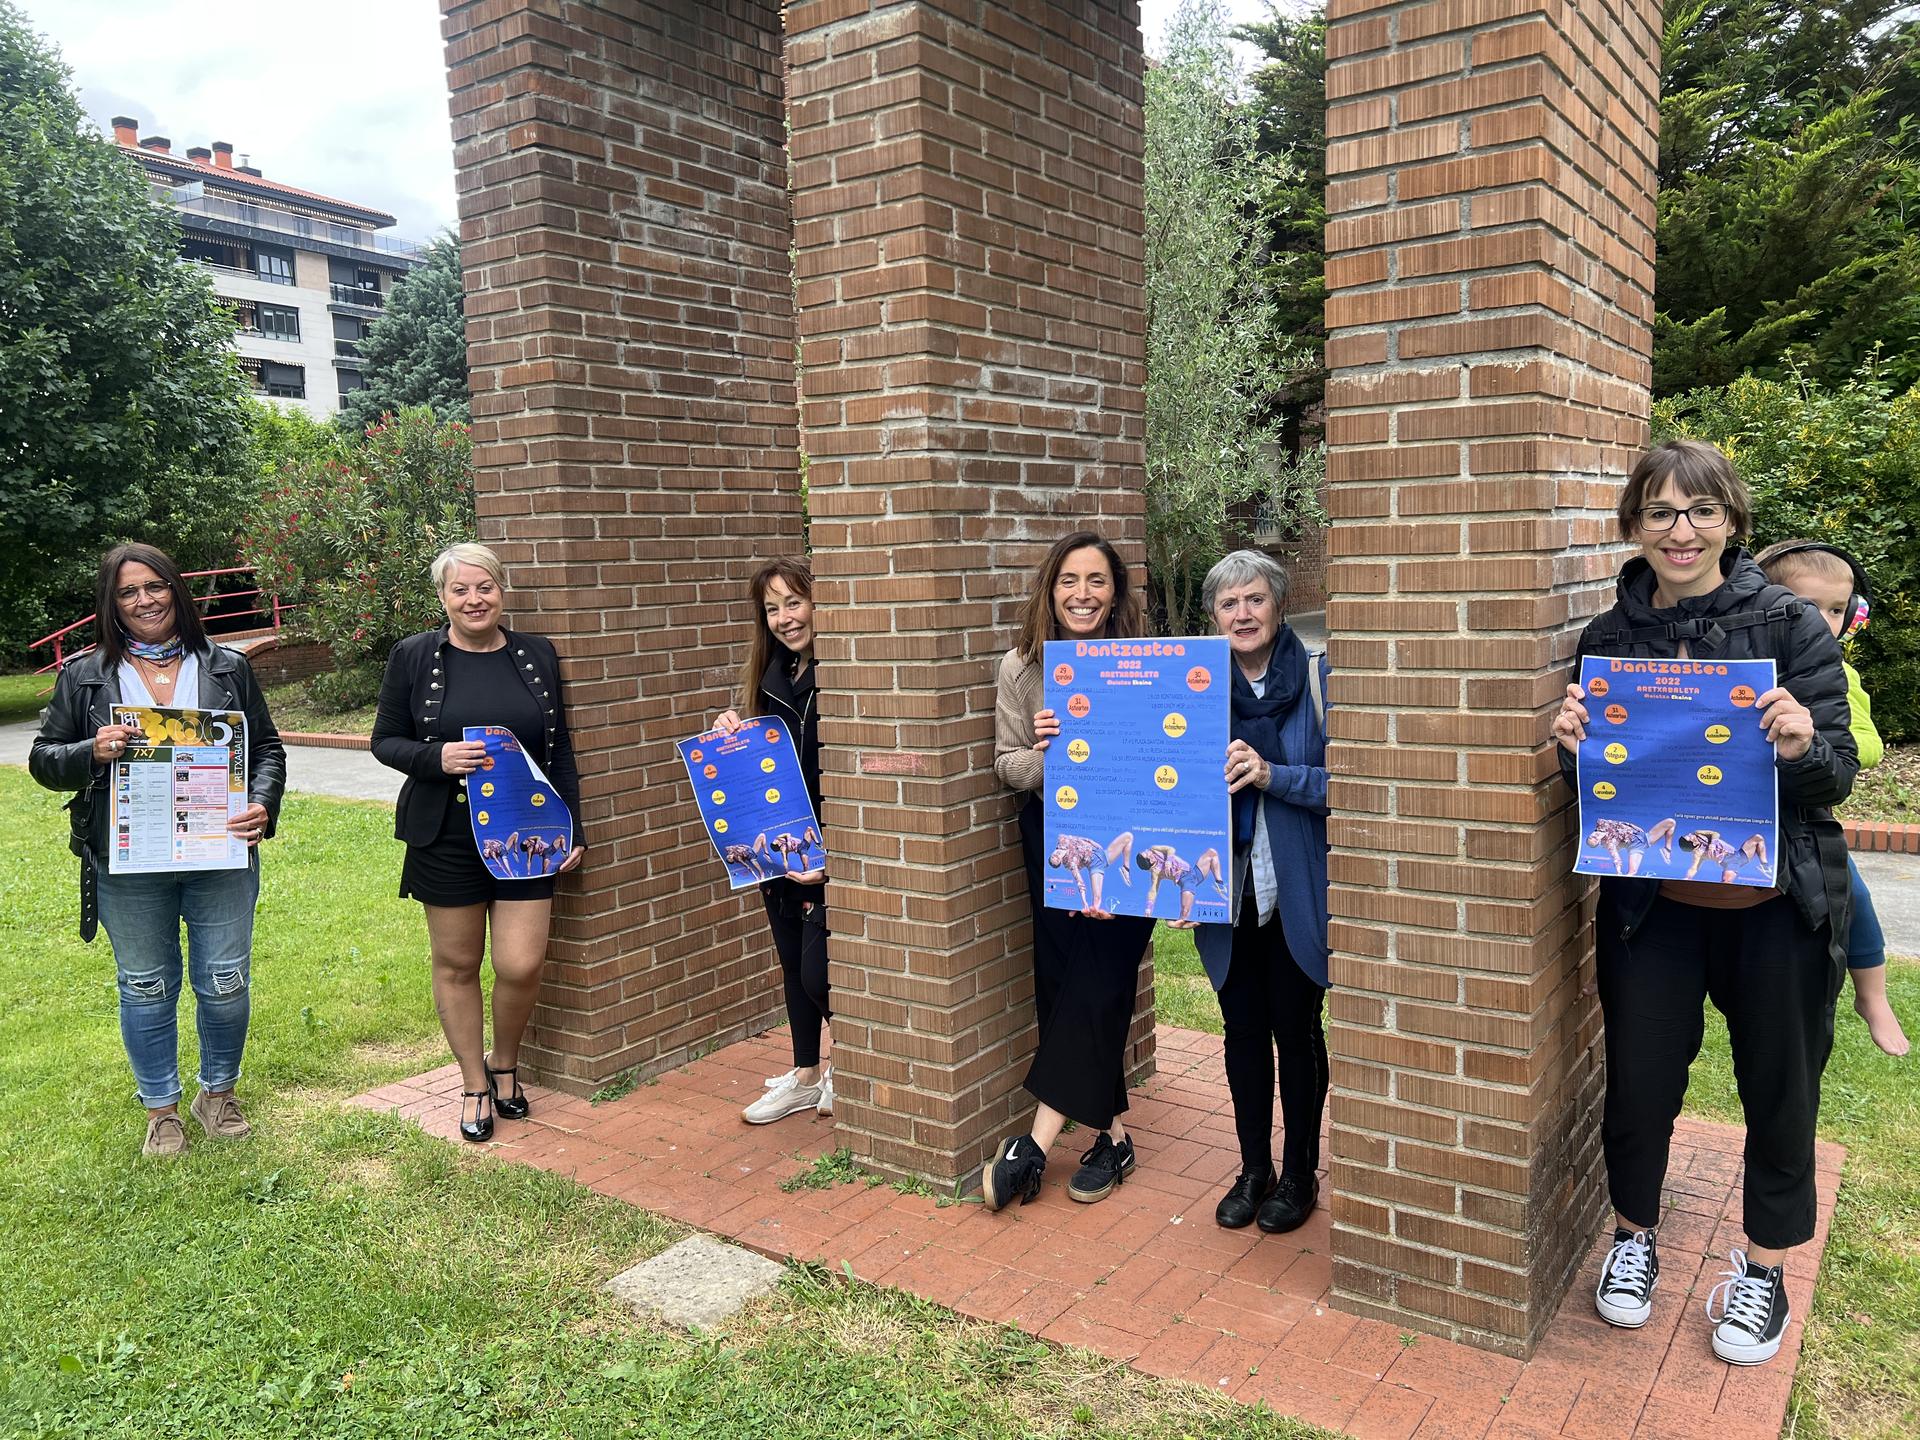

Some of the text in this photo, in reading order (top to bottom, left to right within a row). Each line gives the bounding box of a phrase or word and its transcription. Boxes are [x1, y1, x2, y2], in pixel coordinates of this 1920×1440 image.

[1076, 642, 1185, 657] Dantzastea
[1118, 660, 1142, 669] 2022
[1610, 659, 1728, 676] Dantzastea
[1655, 677, 1681, 686] 2022
[1636, 686, 1700, 694] ARETXABALETA
[233, 724, 244, 788] ARETXABALETA
